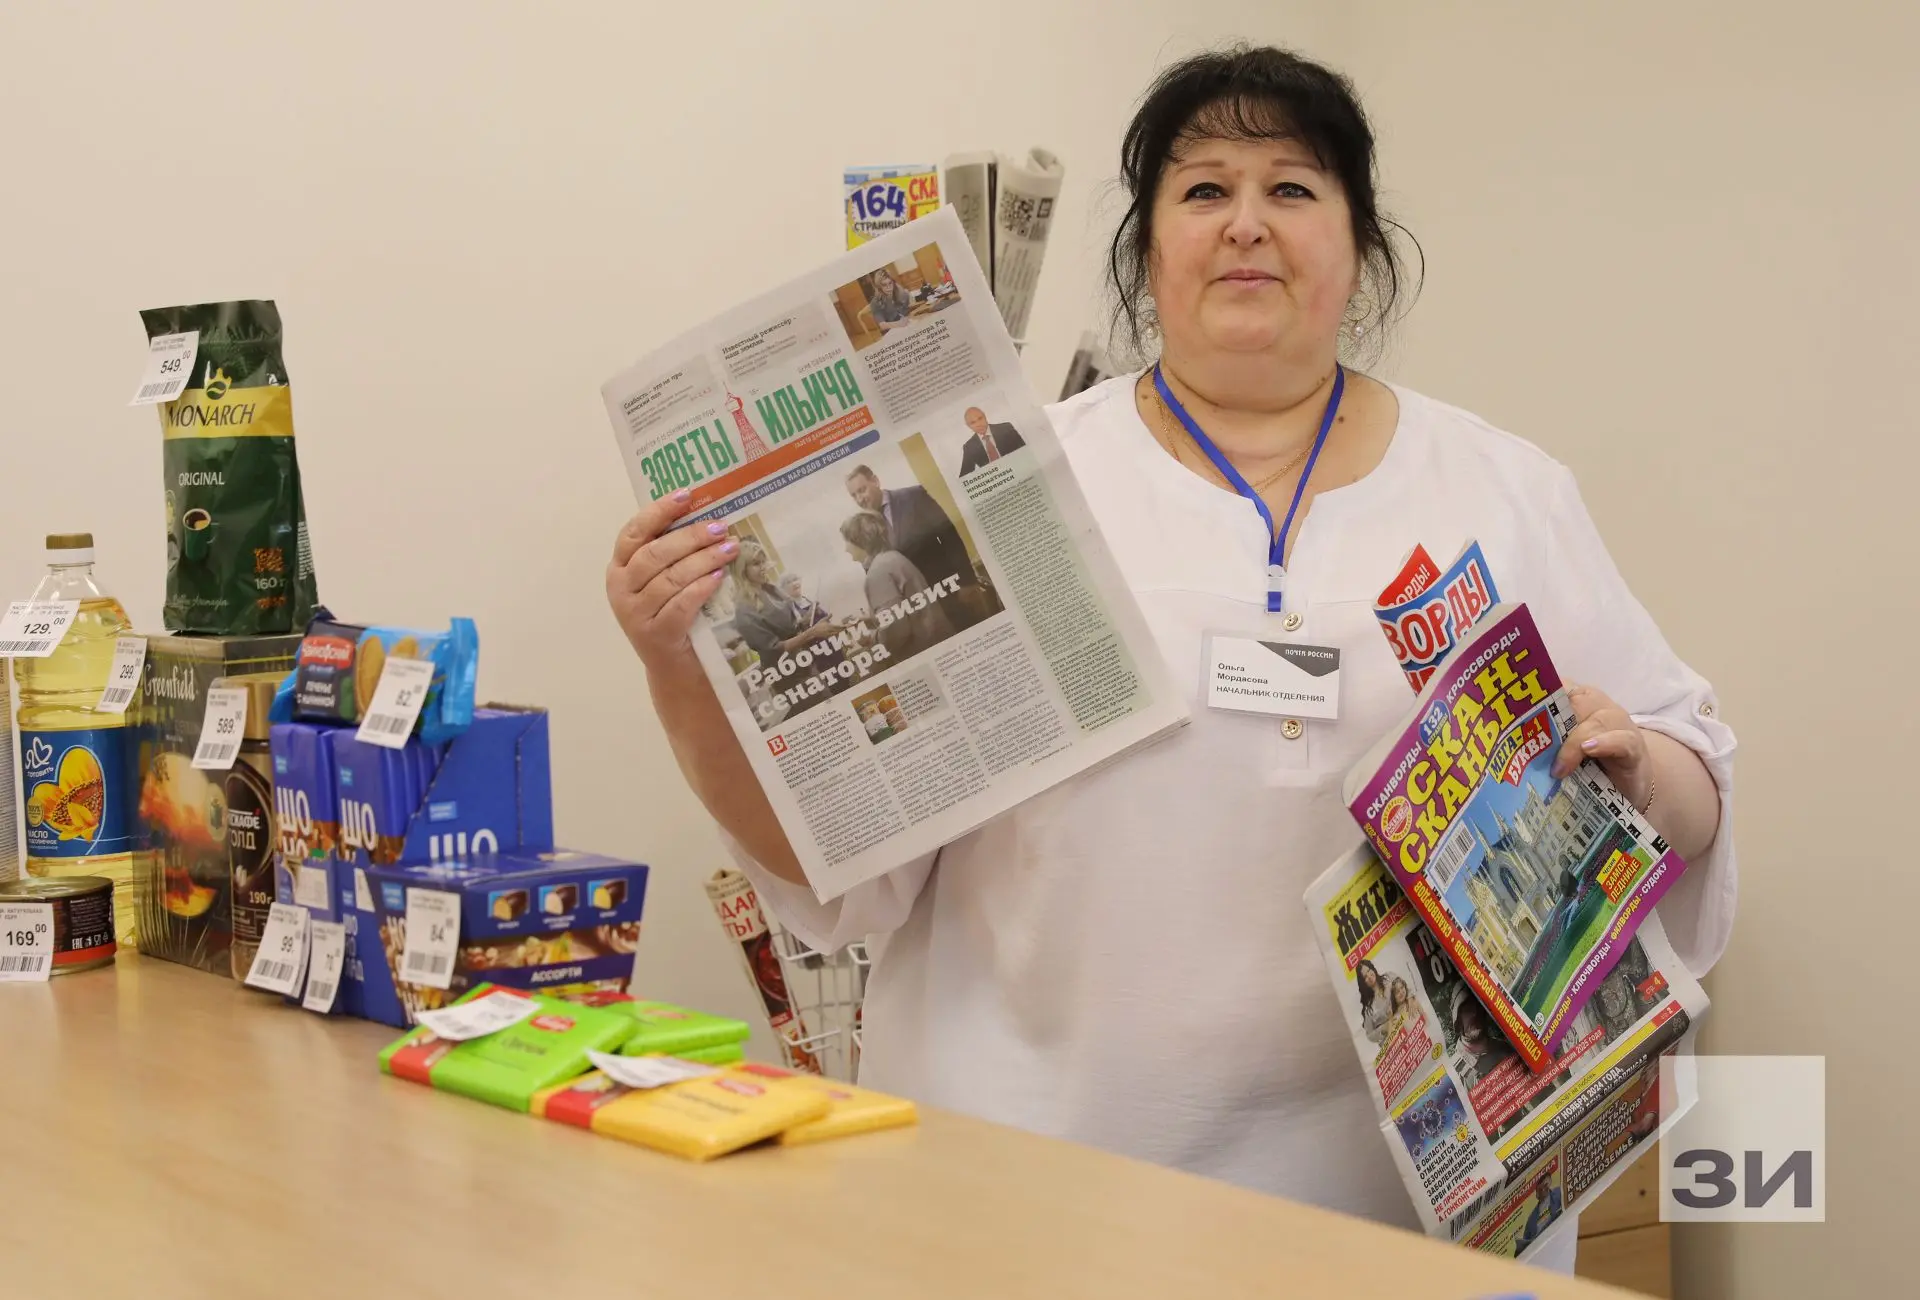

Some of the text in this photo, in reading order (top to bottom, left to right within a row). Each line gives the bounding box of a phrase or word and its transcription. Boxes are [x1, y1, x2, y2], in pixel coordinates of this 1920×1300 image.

[850, 185, 905, 220] 164
[854, 220, 907, 231] СТРАНИЦЫ
[722, 329, 758, 354] Известный
[864, 317, 946, 363] Содействие сенатора РФ
[870, 331, 950, 376] пример сотрудничества
[871, 350, 897, 367] работе
[896, 339, 920, 355] округа
[160, 356, 182, 375] 549.
[873, 366, 897, 382] власти
[897, 358, 913, 370] всех
[167, 402, 256, 428] MONARCH
[641, 419, 739, 501] ЗАВЕТЫ
[755, 358, 864, 444] ИЛЬИЧА
[178, 470, 226, 486] ORIGINAL
[733, 495, 750, 509] ГОД
[749, 476, 787, 501] ЕДИНСТВА
[787, 458, 822, 482] НАРОДОВ
[821, 444, 850, 464] РОССИИ
[962, 464, 999, 487] Полезные
[966, 467, 1013, 494] инициативы
[969, 474, 1015, 501] поощряются
[254, 576, 278, 591] 160
[1391, 563, 1431, 605] ОРДЫ!
[22, 623, 52, 635] 129.
[741, 612, 871, 695] Рабочий
[874, 572, 963, 629] визит
[1218, 662, 1245, 672] Ольга
[1285, 648, 1334, 659] ПОЧТА РОССИИ
[143, 663, 198, 705] Greenfield
[756, 639, 894, 726] сенатора
[1216, 686, 1325, 702] НАЧАЛЬНИК ОТДЕЛЕНИЯ
[1217, 672, 1268, 684] Мордасова
[1366, 741, 1423, 820] СКАНВОРДЫ
[1446, 626, 1522, 704] КРОССВОРДЫ
[1406, 648, 1529, 806] СКАН-
[1424, 706, 1443, 736] 132
[1400, 668, 1549, 874] СКАНЫЧ
[1490, 734, 1522, 780] МЕГА-
[1507, 730, 1552, 786] БУКВА
[341, 798, 379, 851] ШО
[1606, 857, 1628, 890] ЗАМОК
[1610, 859, 1640, 902] ЛЕДНИЦЕ
[1413, 880, 1452, 938] СКАНВОРДОВ
[6, 924, 47, 947] 169. 00
[1541, 862, 1668, 1046] СКАНВОРДЫ КЛЮЧВОРДЫ ФИЛВОРДЫ СУДОКУ
[530, 966, 583, 984] АССОРТИ
[1454, 940, 1497, 998] КРОССВОРДОВ
[1496, 995, 1542, 1062] СУПЕРСБОРНИК
[1470, 1069, 1502, 1098] Мини-очерк
[1480, 1084, 1506, 1107] событиях
[1493, 1105, 1516, 1124] главных
[1516, 1084, 1538, 1109] успехов
[1538, 1064, 1559, 1090] русской
[1558, 1052, 1578, 1071] армии
[1575, 1042, 1589, 1054] 2025
[1589, 1030, 1602, 1045] года
[1506, 1068, 1624, 1167] РАСПИСАЛИСЬ 27 НОЯБРЯ 2024 ГОДА,
[1567, 1101, 1628, 1164] СТОИМОСТЬЮ
[1586, 1098, 1641, 1154] МИЛЛИОНОВ
[1416, 1140, 1447, 1172] В ОБЛАСТИ
[1420, 1143, 1456, 1180] ОТМЕЧАЕТСЯ
[1566, 1116, 1632, 1182] ЕВРО НАЧИНАЛ
[1568, 1136, 1634, 1202] В ЧЕРНОЗЕМЬЕ
[1424, 1156, 1454, 1189] СЕЗОННЫЙ
[1426, 1146, 1478, 1198] ЗАБОЛЕВАЕМОСТИ
[1430, 1188, 1447, 1206] ОРВИ
[1450, 1158, 1480, 1187] ГРИППОМ.
[1567, 1150, 1606, 1192] КАРЬЕРУ
[1434, 1176, 1474, 1215] НЕ ПРОСТЫМ,
[1444, 1176, 1488, 1219] ГОНКОНГСКИМ
